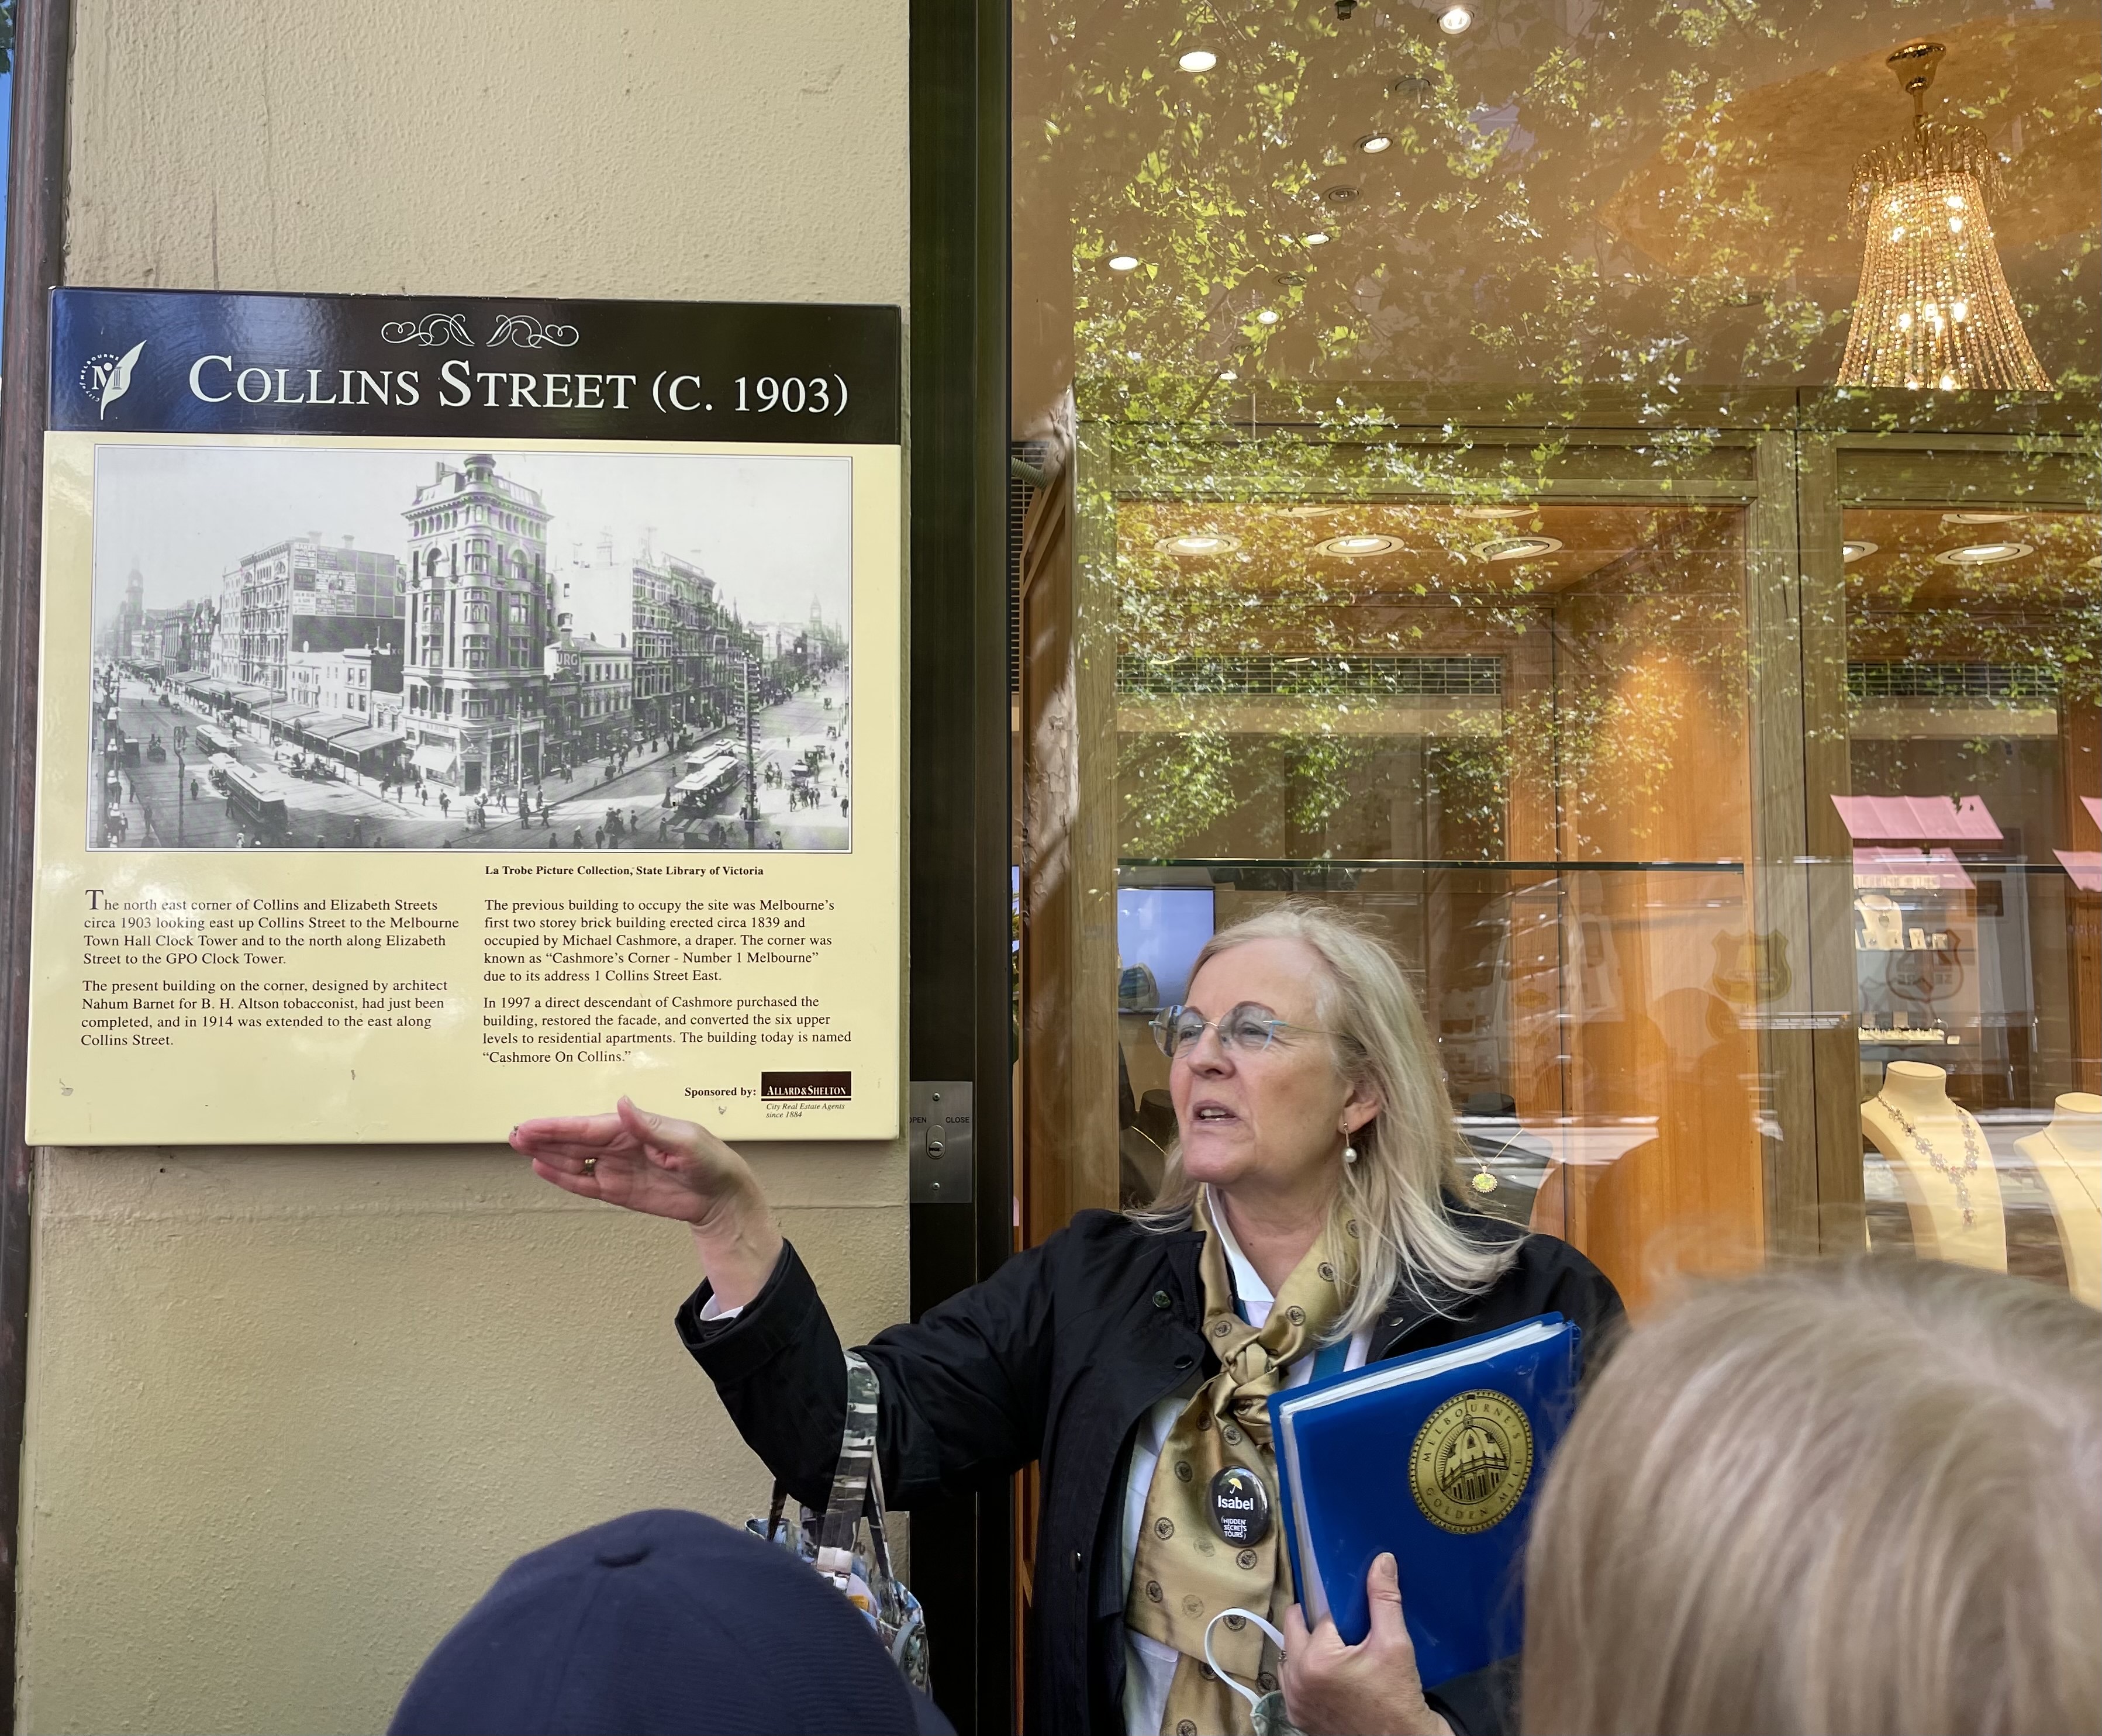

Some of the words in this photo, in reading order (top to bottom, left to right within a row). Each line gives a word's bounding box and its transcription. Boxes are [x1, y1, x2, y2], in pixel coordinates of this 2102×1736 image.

[189, 355, 420, 406] COLLINS
[439, 360, 636, 409] STREET
[652, 371, 712, 413] (C.
[734, 373, 848, 416] 1903)
[485, 865, 499, 875] La
[502, 865, 533, 875] Trobe
[536, 865, 574, 875] Picture
[577, 865, 634, 876] Collection,
[636, 865, 663, 875] State
[665, 866, 707, 878] Library
[709, 866, 721, 875] of
[722, 866, 764, 875] Victoria
[85, 889, 120, 910] The
[123, 899, 157, 910] north
[161, 900, 187, 910] east
[191, 902, 232, 910] corner
[236, 899, 251, 910] of
[253, 899, 299, 910] Collins
[303, 899, 327, 910] and
[330, 899, 391, 910] Elizabeth
[394, 899, 438, 910] Streets
[484, 899, 509, 911] The
[512, 899, 565, 914] previous
[568, 899, 619, 913] building
[622, 900, 635, 910] to
[638, 902, 682, 913] occupy
[685, 899, 705, 910] the
[707, 899, 729, 910] site
[732, 902, 756, 910] was
[84, 917, 116, 929] circa
[121, 916, 151, 929] 1903
[156, 917, 205, 931] looking
[209, 916, 234, 929] east
[238, 920, 254, 931] up
[258, 916, 305, 929] Collins
[308, 917, 346, 929] Street
[349, 918, 363, 929] to
[366, 917, 386, 929] the
[389, 917, 460, 929] Melbourne
[484, 917, 510, 929] first
[513, 919, 536, 929] two
[539, 918, 577, 931] storey
[580, 916, 613, 928] brick
[615, 916, 667, 931] building
[669, 917, 714, 928] erected
[717, 916, 747, 928] circa
[751, 916, 781, 929] 1839
[783, 917, 806, 928] and
[83, 935, 120, 947] Town
[123, 935, 151, 947] Hall
[155, 934, 195, 947] Clock
[197, 935, 239, 947] Tower
[241, 934, 265, 947] and
[268, 936, 281, 947] to
[285, 934, 305, 946] the
[308, 934, 343, 946] north
[346, 934, 382, 949] along
[385, 934, 447, 946] Elizabeth
[484, 934, 540, 949] occupied
[543, 934, 559, 949] by
[561, 934, 613, 946] Michael
[616, 934, 681, 948] Cashmore,
[685, 937, 692, 945] a
[695, 934, 737, 949] draper.
[740, 934, 764, 945] The
[767, 937, 806, 945] corner
[809, 937, 832, 945] was
[83, 952, 122, 965] Street
[125, 954, 138, 964] to
[141, 952, 162, 964] the
[165, 952, 198, 964] GPO
[201, 952, 240, 964] Clock
[243, 952, 286, 964] Tower.
[484, 952, 526, 964] known
[529, 955, 542, 964] as
[627, 952, 671, 964] Corner
[682, 952, 733, 964] Number
[737, 952, 742, 963] 1
[483, 970, 506, 982] due
[509, 972, 522, 982] to
[525, 969, 540, 982] its
[544, 970, 590, 981] address
[595, 970, 600, 981] 1
[605, 969, 650, 981] Collins
[653, 969, 689, 981] Street
[692, 969, 722, 981] East.
[82, 980, 108, 992] The
[111, 982, 159, 995] present
[163, 979, 216, 995] building
[220, 982, 236, 991] on
[240, 979, 260, 992] the
[263, 982, 308, 993] corner,
[312, 979, 369, 994] designed
[372, 979, 389, 994] by
[392, 979, 448, 991] architect
[483, 997, 496, 1009] In
[501, 996, 530, 1009] 1997
[534, 1000, 542, 1008] a
[545, 996, 581, 1008] direct
[584, 996, 653, 1008] descendant
[655, 996, 669, 1007] of
[671, 996, 733, 1007] Cashmore
[736, 996, 798, 1010] purchased
[800, 996, 820, 1007] the
[482, 1014, 538, 1029] building,
[541, 1014, 592, 1026] restored
[595, 1014, 614, 1026] the
[617, 1014, 661, 1027] facade,
[664, 1014, 687, 1026] and
[690, 1013, 749, 1025] converted
[753, 1013, 772, 1025] the
[775, 1013, 793, 1025] six
[796, 1016, 831, 1028] upper
[81, 1034, 128, 1046] Collins
[132, 1034, 174, 1046] Street.
[482, 1033, 519, 1044] levels
[522, 1034, 534, 1044] to
[537, 1032, 602, 1044] residential
[605, 1033, 676, 1047] apartments.
[679, 1031, 703, 1043] The
[706, 1031, 758, 1045] building
[761, 1031, 795, 1045] today
[798, 1031, 808, 1043] is
[812, 1031, 851, 1043] named
[684, 1087, 737, 1099] Sponsored
[740, 1086, 757, 1098] by:
[767, 1085, 846, 1095] ALLARD&SHELTON
[1217, 1495, 1254, 1510] Isabel
